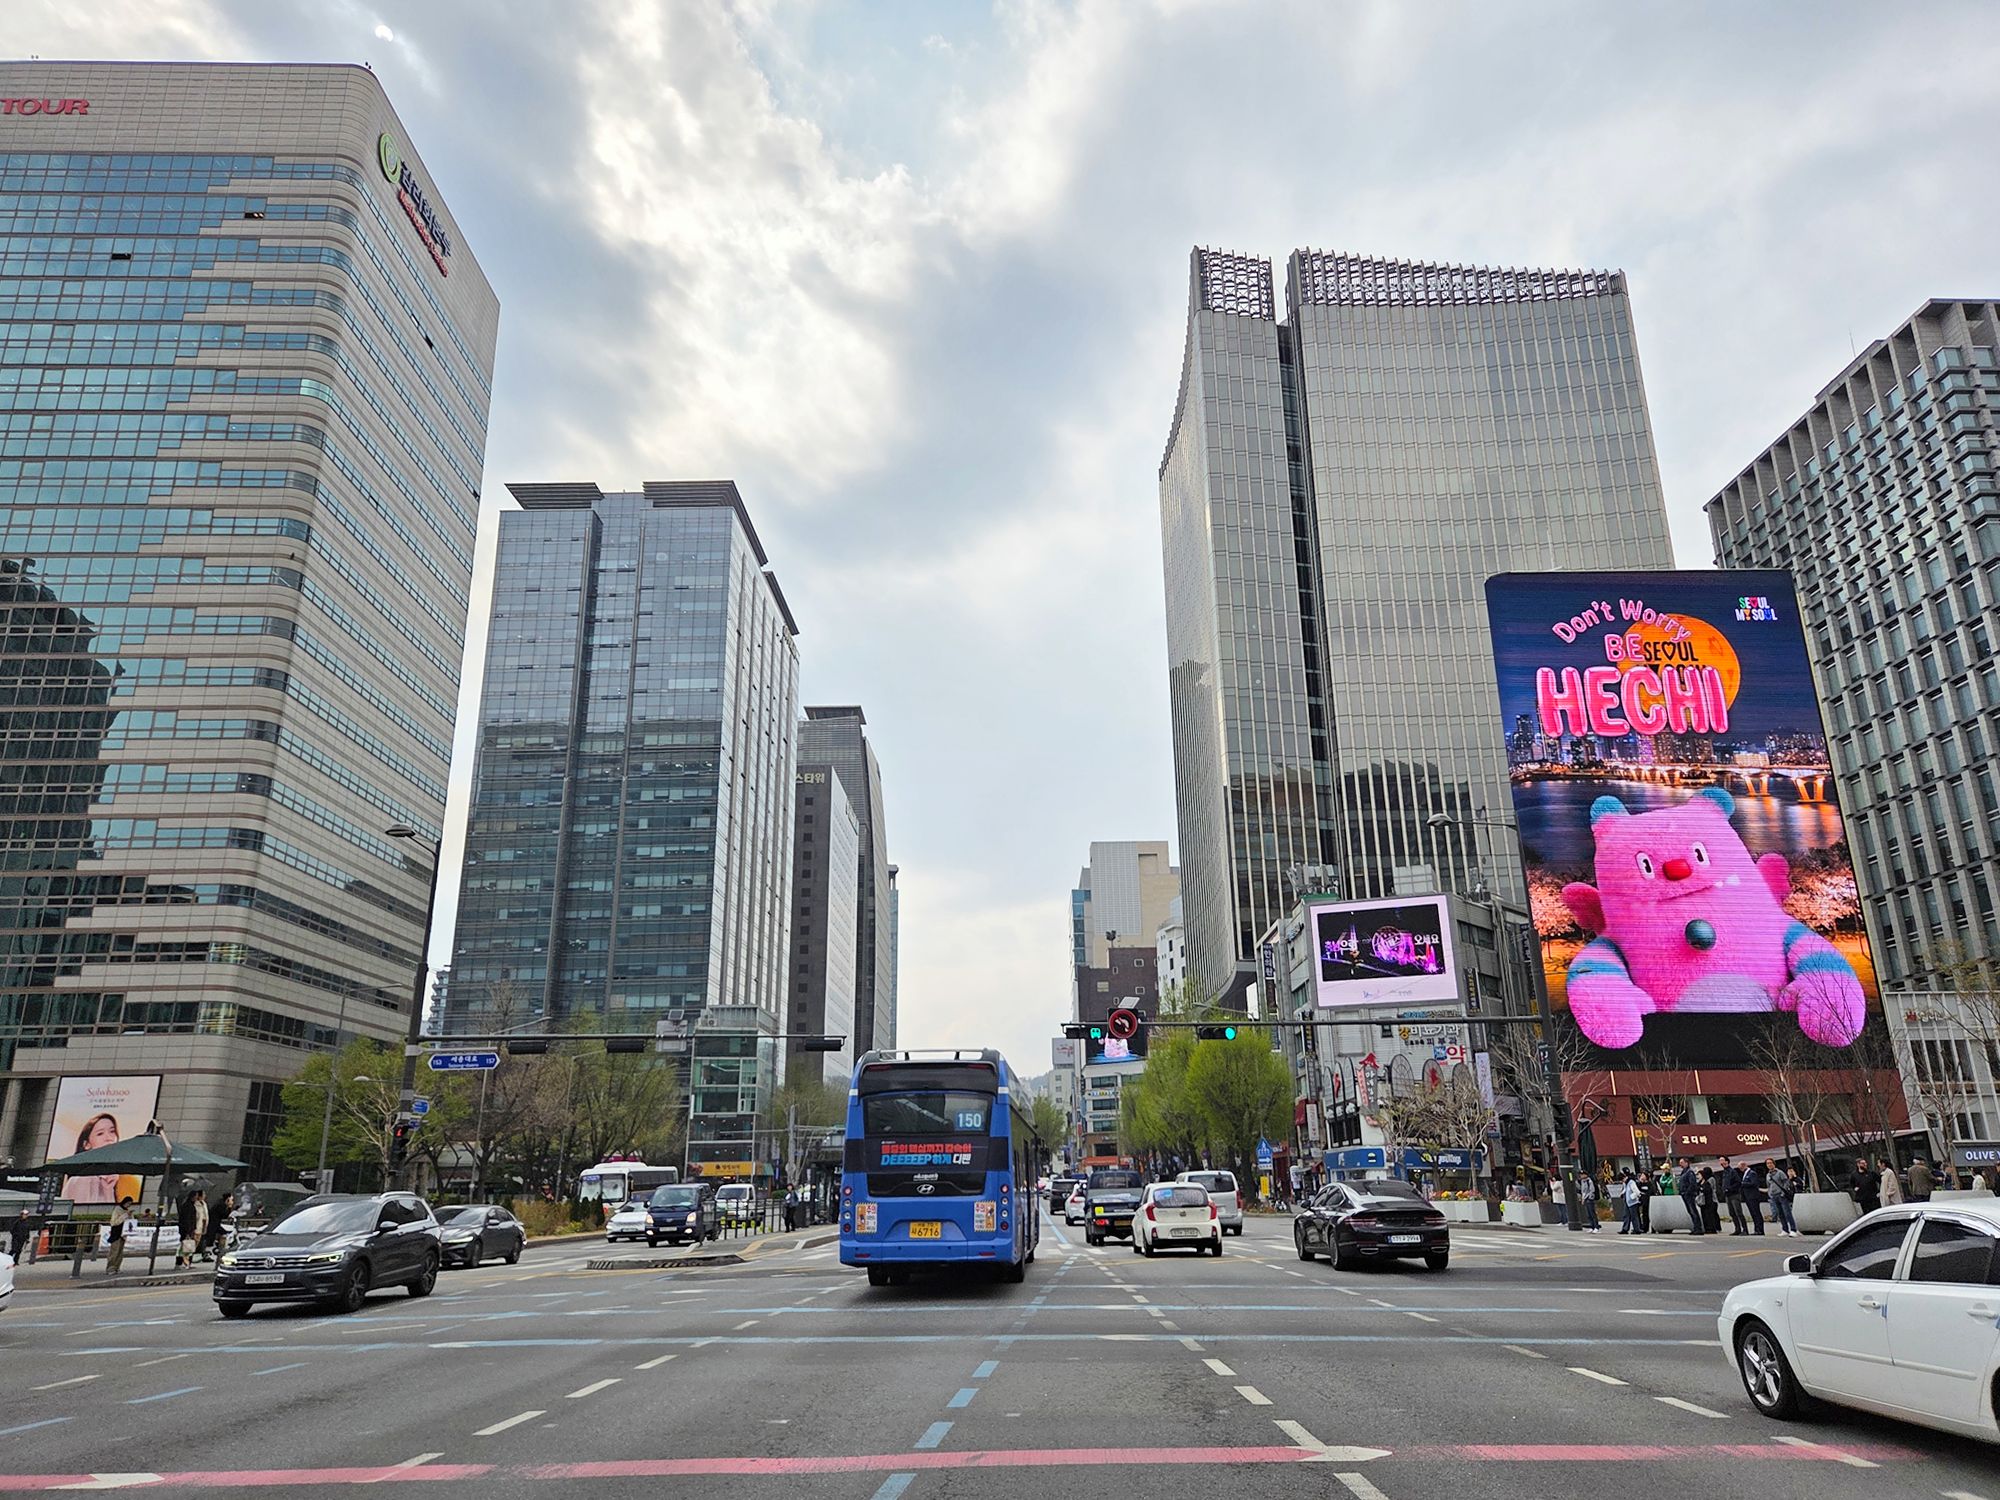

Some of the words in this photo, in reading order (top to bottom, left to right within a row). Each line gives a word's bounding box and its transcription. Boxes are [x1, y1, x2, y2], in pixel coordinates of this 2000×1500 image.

[0, 98, 89, 116] TOUR
[1552, 601, 1615, 643] Don't
[1619, 598, 1691, 643] Worry
[1752, 609, 1778, 621] SOUL
[1604, 633, 1645, 662] BE
[1536, 666, 1729, 738] HECHI
[1446, 1045, 1466, 1064] 약
[957, 1113, 982, 1128] 150
[1682, 1135, 1708, 1145] 고디바
[1736, 1134, 1770, 1142] GODIVA
[1965, 1151, 1995, 1161] OLIVE
